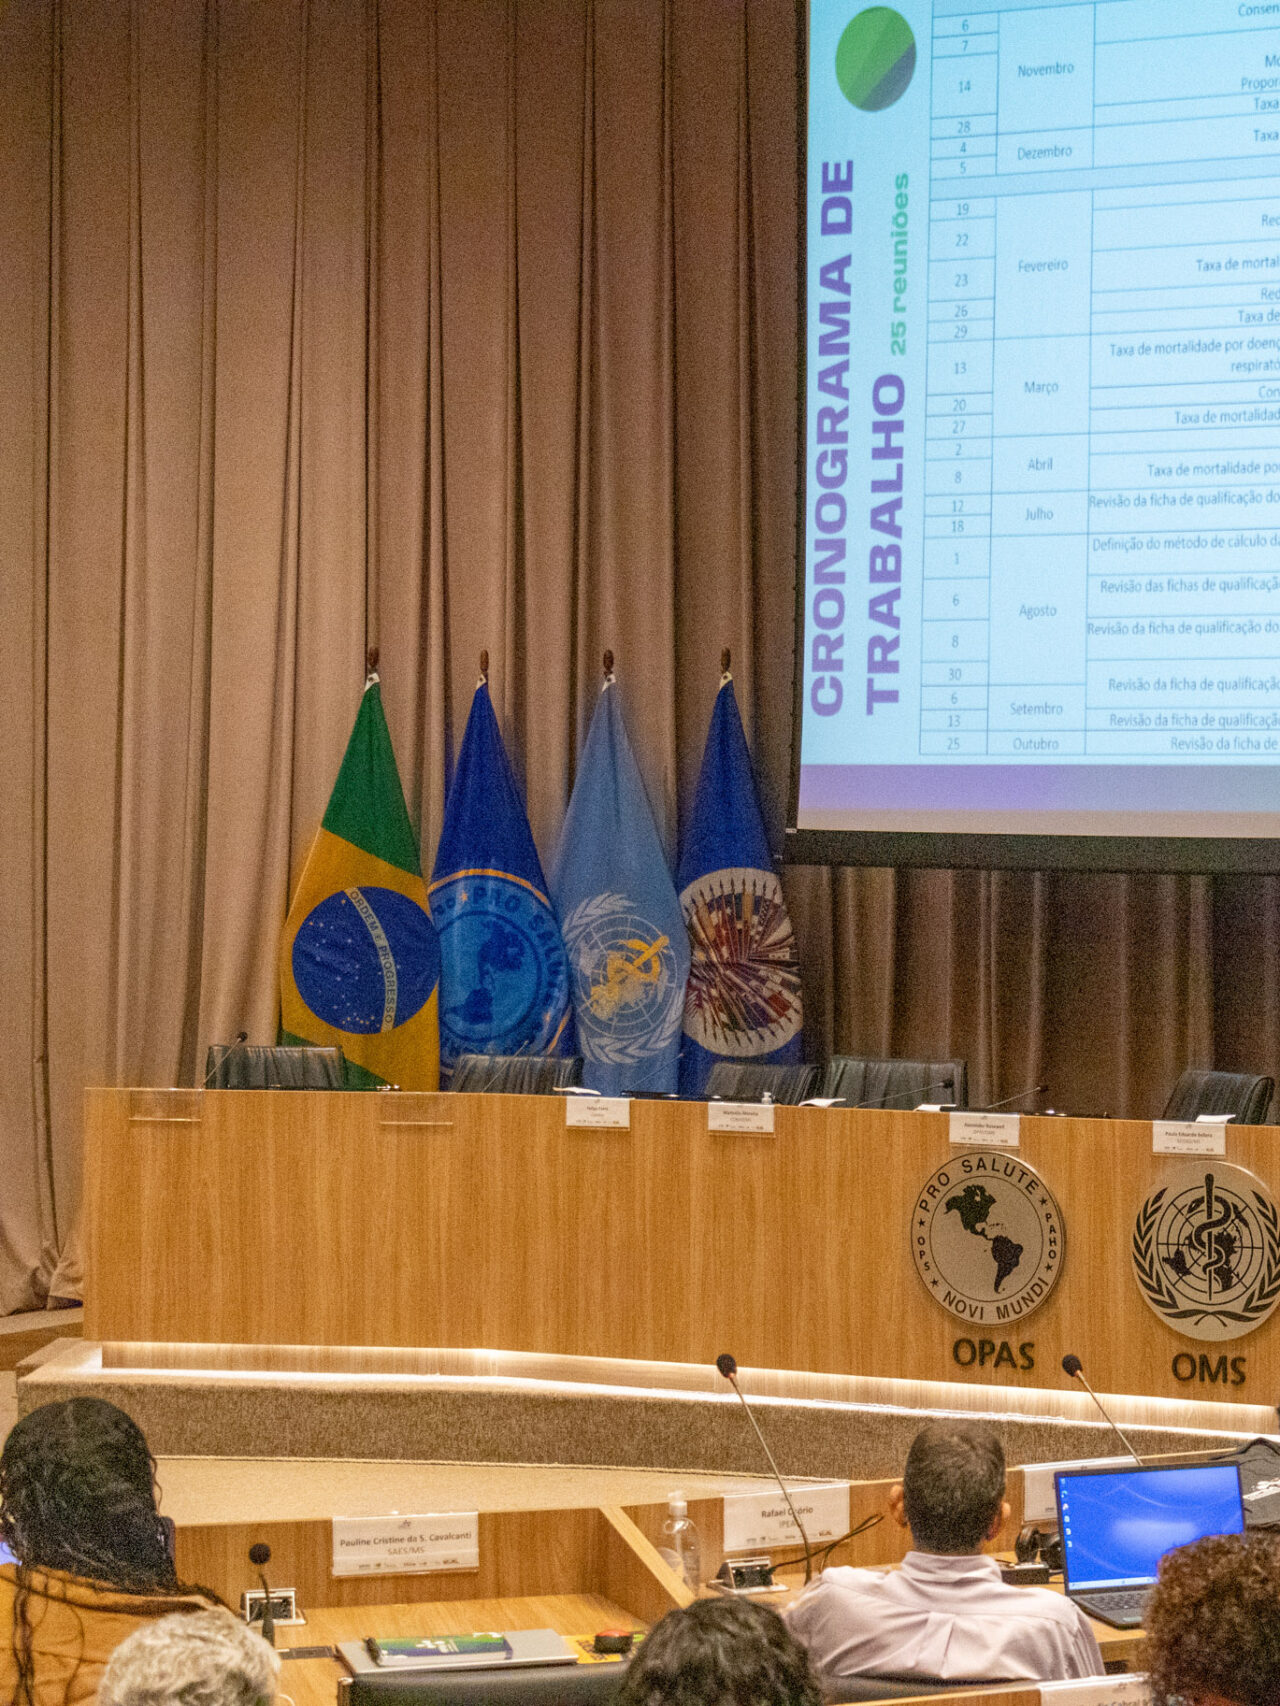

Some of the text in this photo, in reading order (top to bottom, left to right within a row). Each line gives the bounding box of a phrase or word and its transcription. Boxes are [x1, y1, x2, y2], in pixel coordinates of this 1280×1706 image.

[960, 19, 969, 31] 6
[961, 39, 969, 51] 7
[1016, 62, 1075, 78] Novembro
[958, 80, 972, 93] 14
[957, 121, 971, 133] 28
[1253, 130, 1280, 142] Taxa
[959, 142, 967, 153] 4
[1016, 145, 1073, 160] Dezembro
[959, 162, 966, 173] 5
[956, 204, 970, 216] 19
[955, 234, 970, 246] 22
[891, 173, 908, 356] 25 reuniões
[1017, 259, 1069, 273] Fevereiro
[1196, 260, 1222, 272] Taxa
[1223, 258, 1240, 270] de
[954, 274, 969, 286] 23
[954, 305, 968, 317] 26
[954, 326, 968, 338] 29
[953, 362, 967, 374] 13
[1023, 381, 1060, 394] Março
[952, 399, 966, 411] 20
[952, 421, 966, 433] 27
[811, 160, 854, 716] CRONOGRAMA DE
[954, 444, 962, 455] 2
[1026, 458, 1054, 471] Abril
[953, 472, 962, 483] 8
[951, 500, 964, 512] 12
[1025, 508, 1054, 520] Julho
[951, 520, 964, 532] 18
[866, 374, 905, 715] TRABALHO
[951, 594, 960, 606] 6
[1018, 604, 1058, 619] Agosto
[950, 636, 960, 647] 8
[948, 669, 962, 680] 30
[949, 693, 958, 705] 6
[1009, 702, 1064, 714] Setembro
[947, 715, 961, 727] 13
[946, 738, 960, 749] 25
[1012, 738, 1059, 750] Outubro
[1170, 738, 1213, 750] Revisão
[1215, 738, 1230, 750] da
[1233, 738, 1261, 750] ficha
[1263, 738, 1277, 750] de
[351, 891, 379, 933] ORDEM
[378, 945, 396, 1024] PROGRESSO
[920, 1157, 1039, 1212] PRO SALUTE
[1046, 1212, 1056, 1260] PAHO
[917, 1236, 930, 1272] OPS
[942, 1276, 1050, 1320] NOVI MUNDI
[953, 1338, 1035, 1370] OPAS
[1172, 1353, 1246, 1385] OMS
[762, 1508, 814, 1518] Rafael Oório
[340, 1538, 371, 1547] Pauline
[373, 1537, 404, 1545] Cristine
[429, 1532, 472, 1541] Cavalcanti
